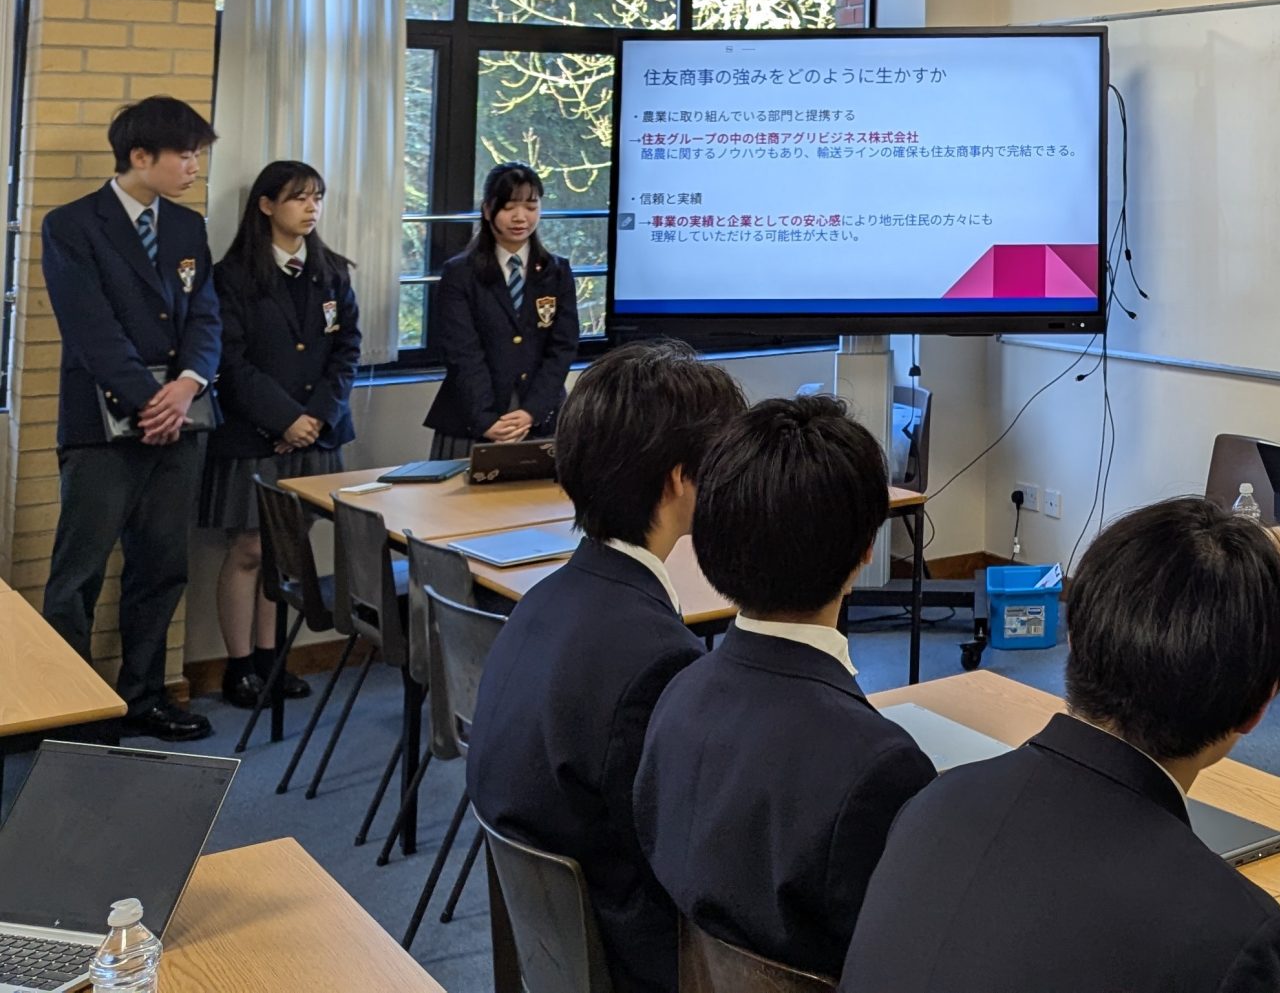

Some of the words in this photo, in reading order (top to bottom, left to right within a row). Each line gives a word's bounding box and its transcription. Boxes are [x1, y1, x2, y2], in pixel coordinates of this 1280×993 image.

[644, 66, 947, 87] 住友商事の強みをどのように生かすか
[650, 229, 860, 243] 理解していただける可能性が大きい。
